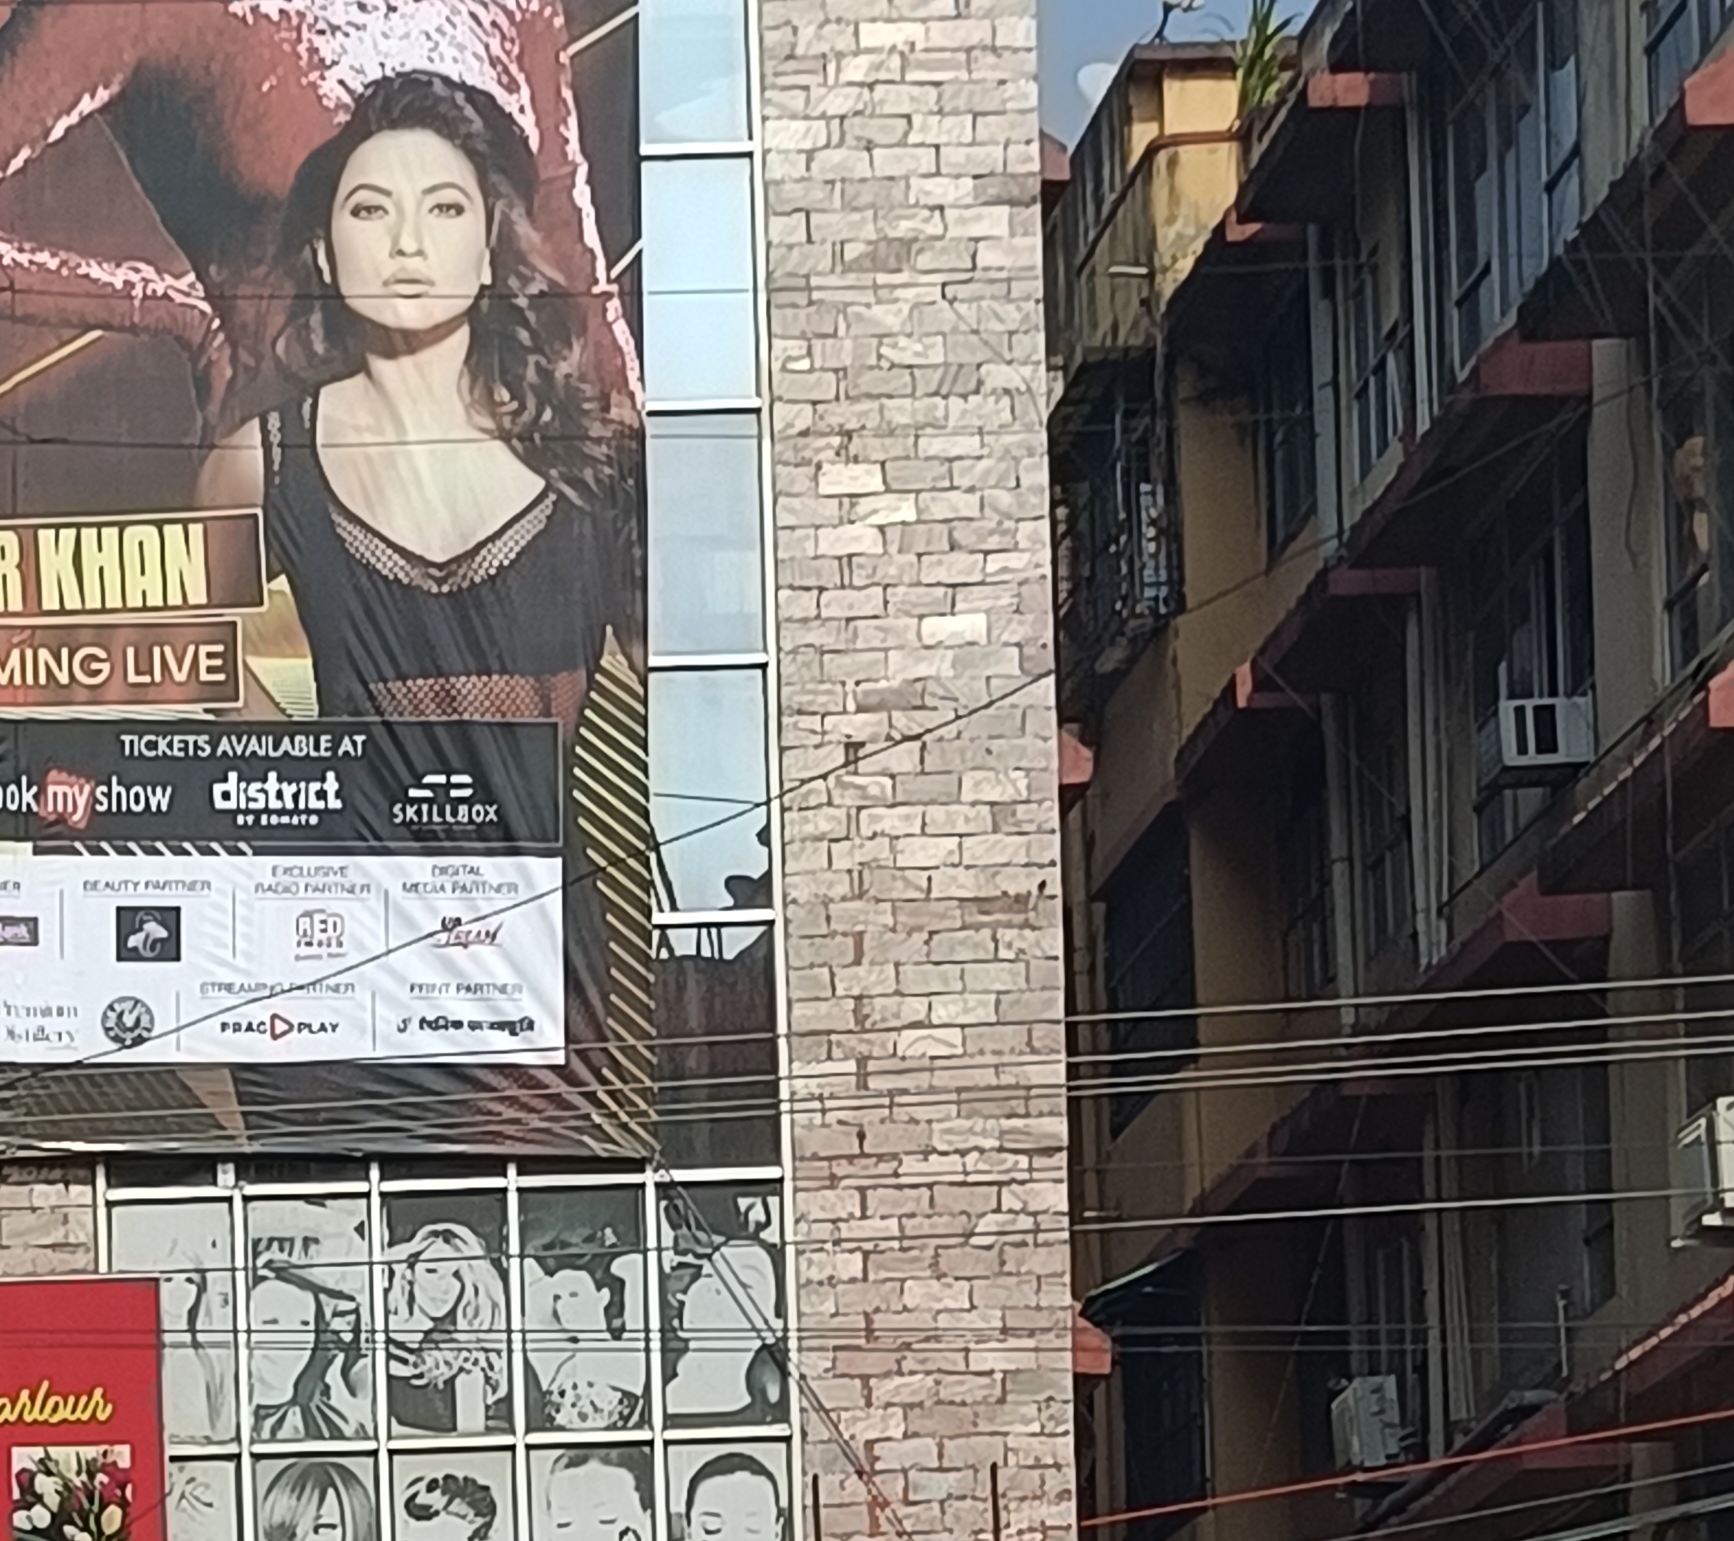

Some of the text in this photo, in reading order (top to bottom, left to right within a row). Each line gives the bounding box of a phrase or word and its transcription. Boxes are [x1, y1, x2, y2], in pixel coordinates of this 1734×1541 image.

[35, 521, 209, 613] KHAN
[123, 643, 228, 685] LIVE
[119, 732, 367, 759] TICKETS AVAILABLE AT
[211, 769, 344, 812] district
[391, 801, 500, 825] SKILLBOX
